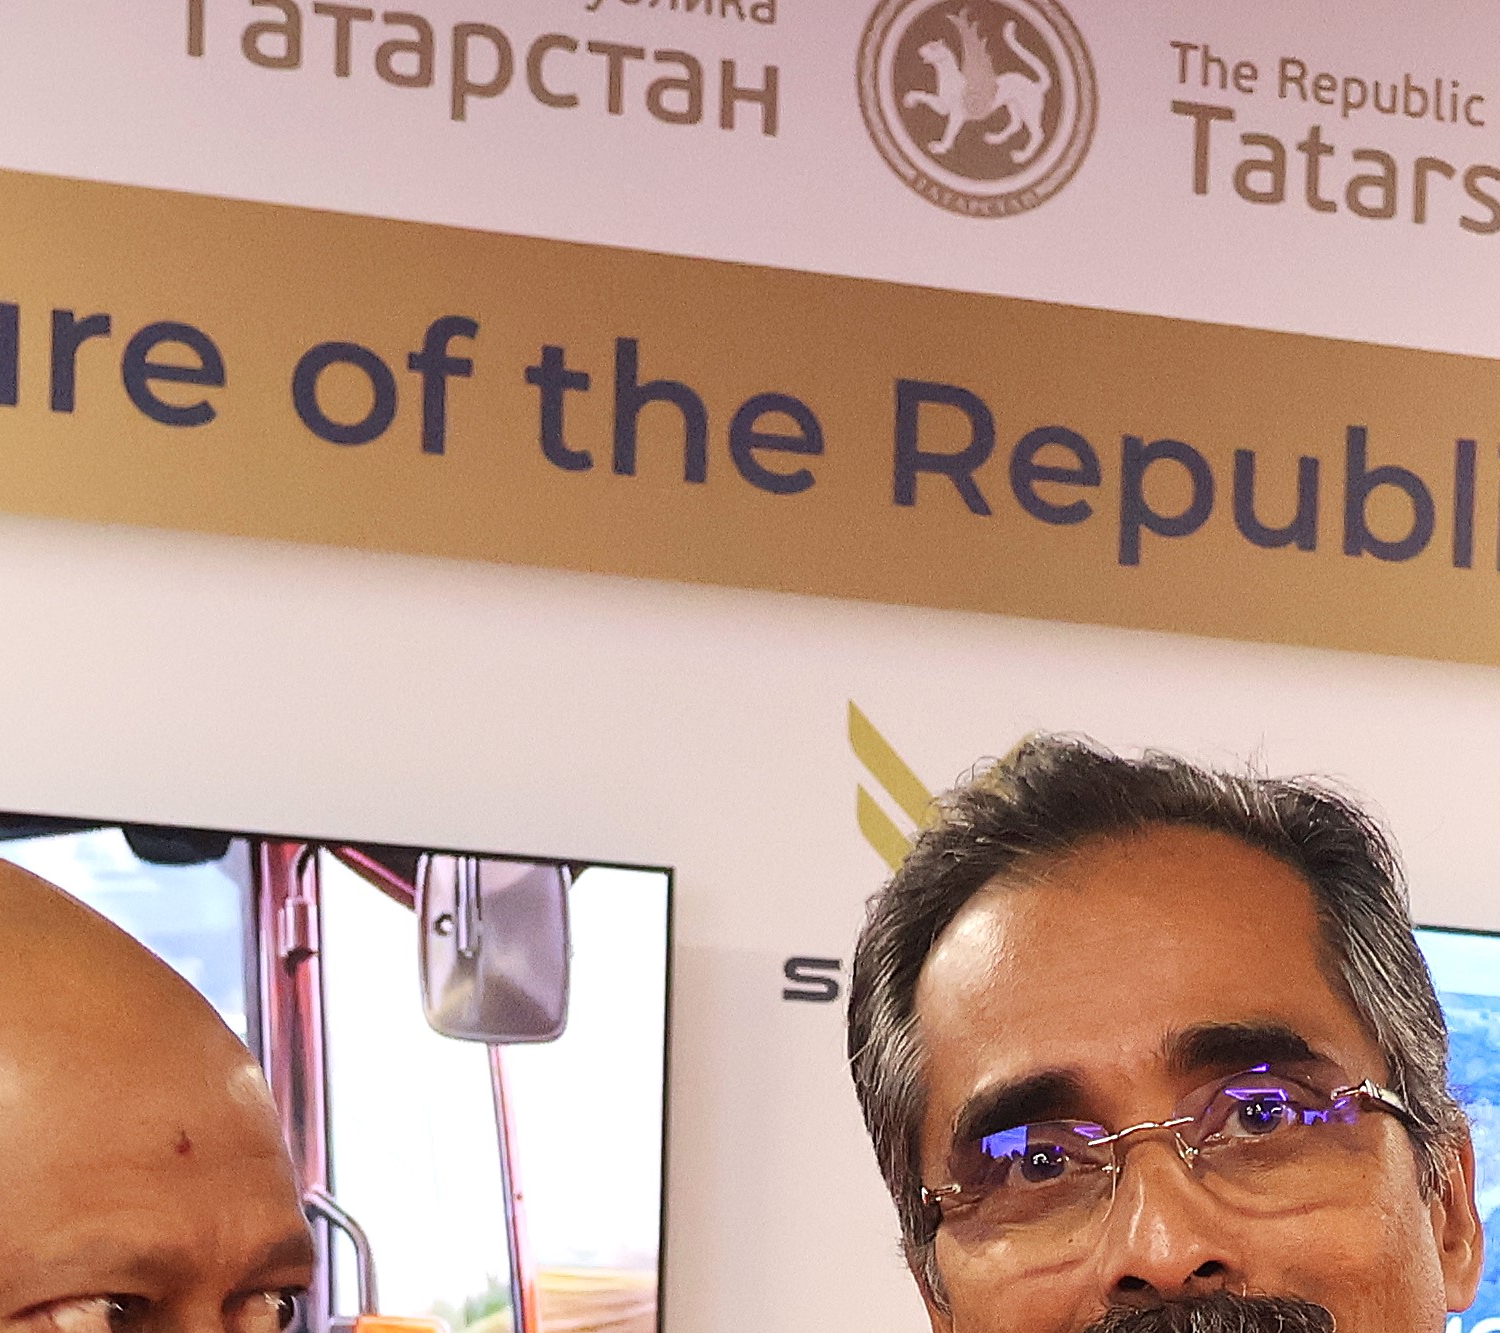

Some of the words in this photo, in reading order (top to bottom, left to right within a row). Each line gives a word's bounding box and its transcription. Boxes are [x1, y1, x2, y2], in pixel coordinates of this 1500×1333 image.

[1169, 40, 1259, 95] The
[1277, 56, 1485, 128] Republic
[291, 314, 480, 456] of
[524, 336, 825, 496] the
